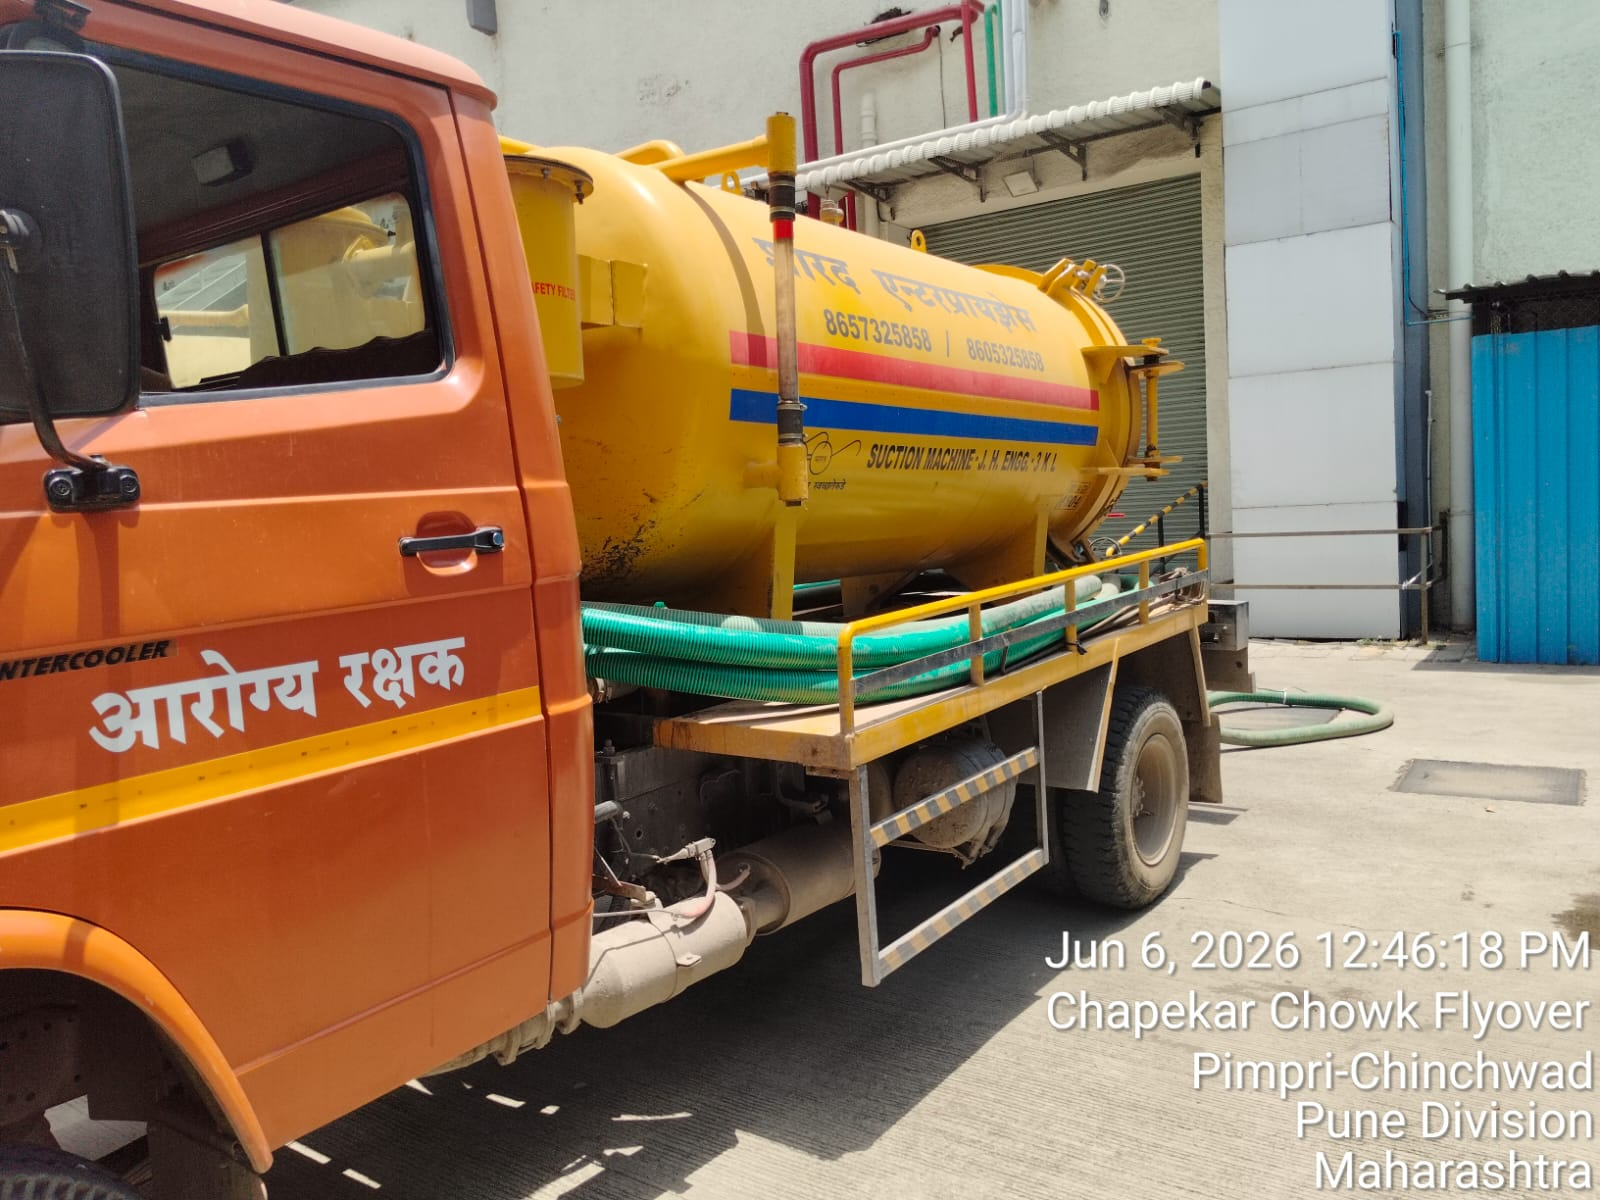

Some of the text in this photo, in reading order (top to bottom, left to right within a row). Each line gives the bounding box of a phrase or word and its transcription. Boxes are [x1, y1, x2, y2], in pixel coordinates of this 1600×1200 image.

[823, 308, 932, 353] 8657325858
[965, 337, 1045, 373] 8605325858
[867, 443, 925, 470] SUCTION
[89, 636, 466, 753] आरोग्य रक्षक
